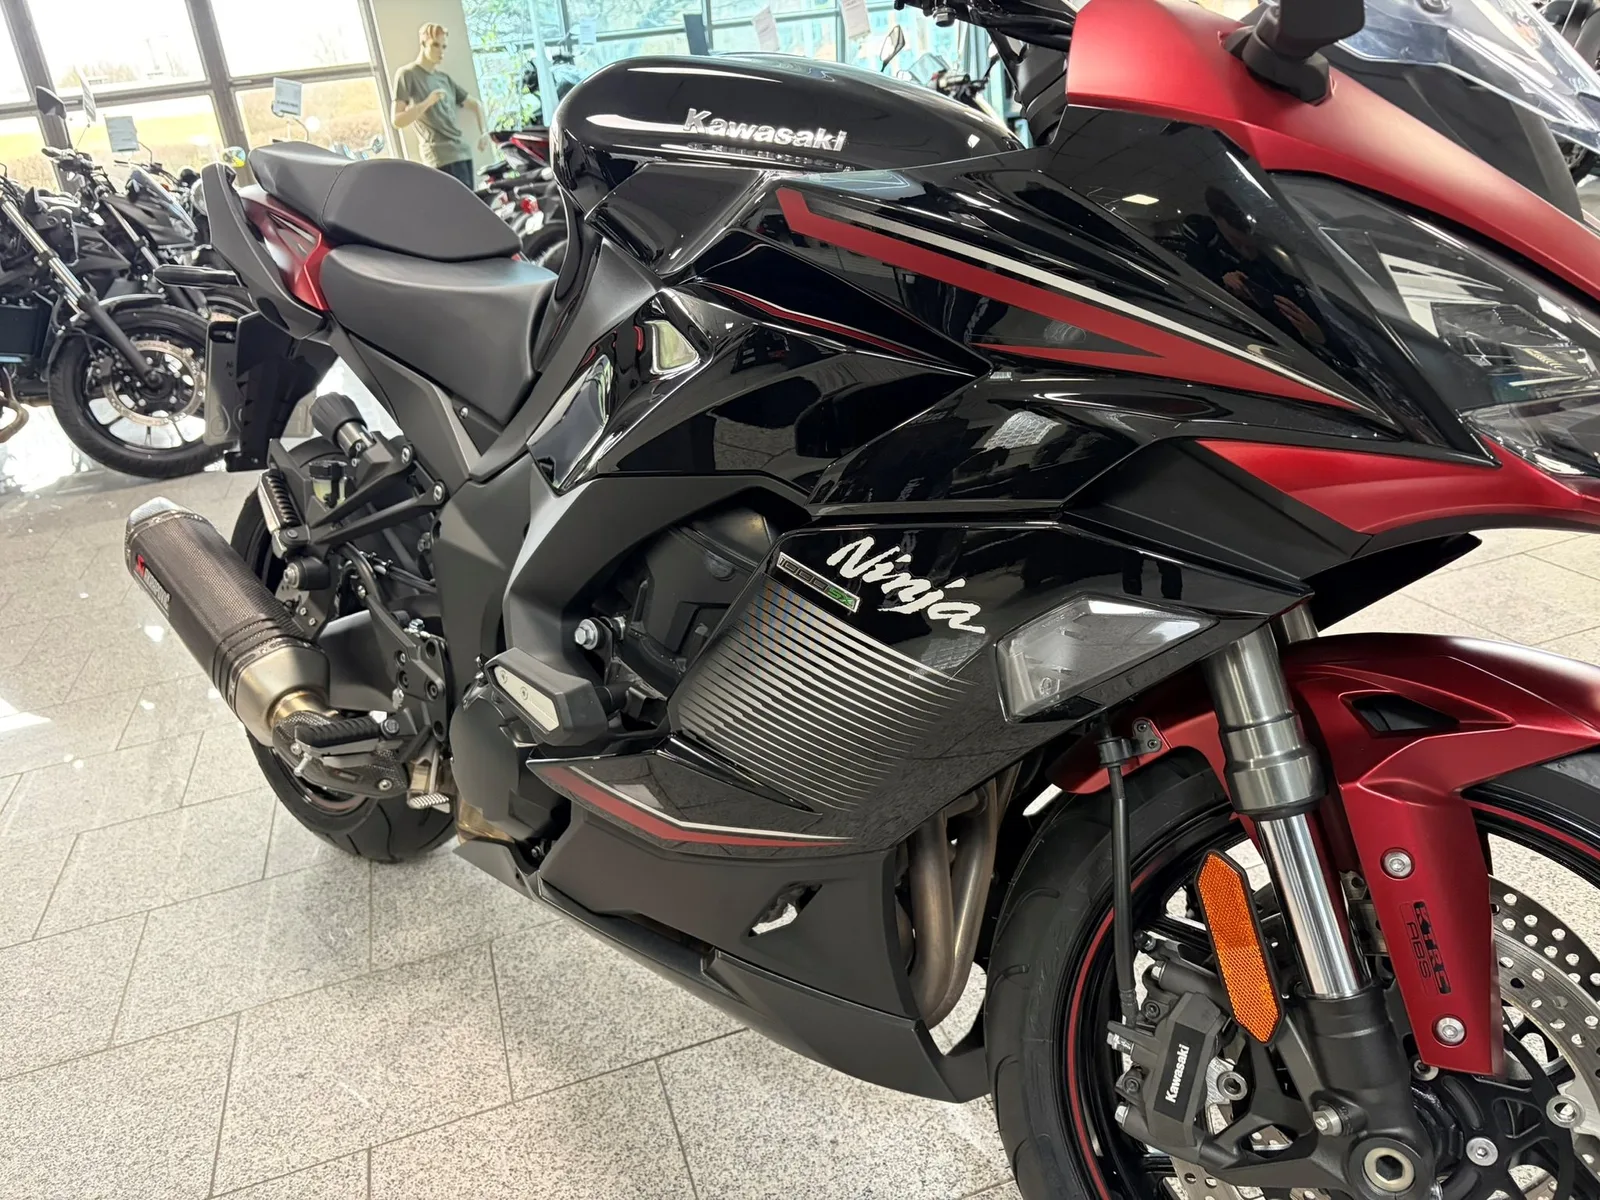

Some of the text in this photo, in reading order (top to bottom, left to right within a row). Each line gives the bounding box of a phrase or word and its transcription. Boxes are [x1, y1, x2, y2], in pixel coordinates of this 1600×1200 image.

[683, 108, 847, 151] Kawasaki
[826, 536, 986, 634] Ninja
[1406, 921, 1432, 979] ABS
[1413, 901, 1452, 994] KTRC
[1165, 1043, 1190, 1103] Kawasaki
